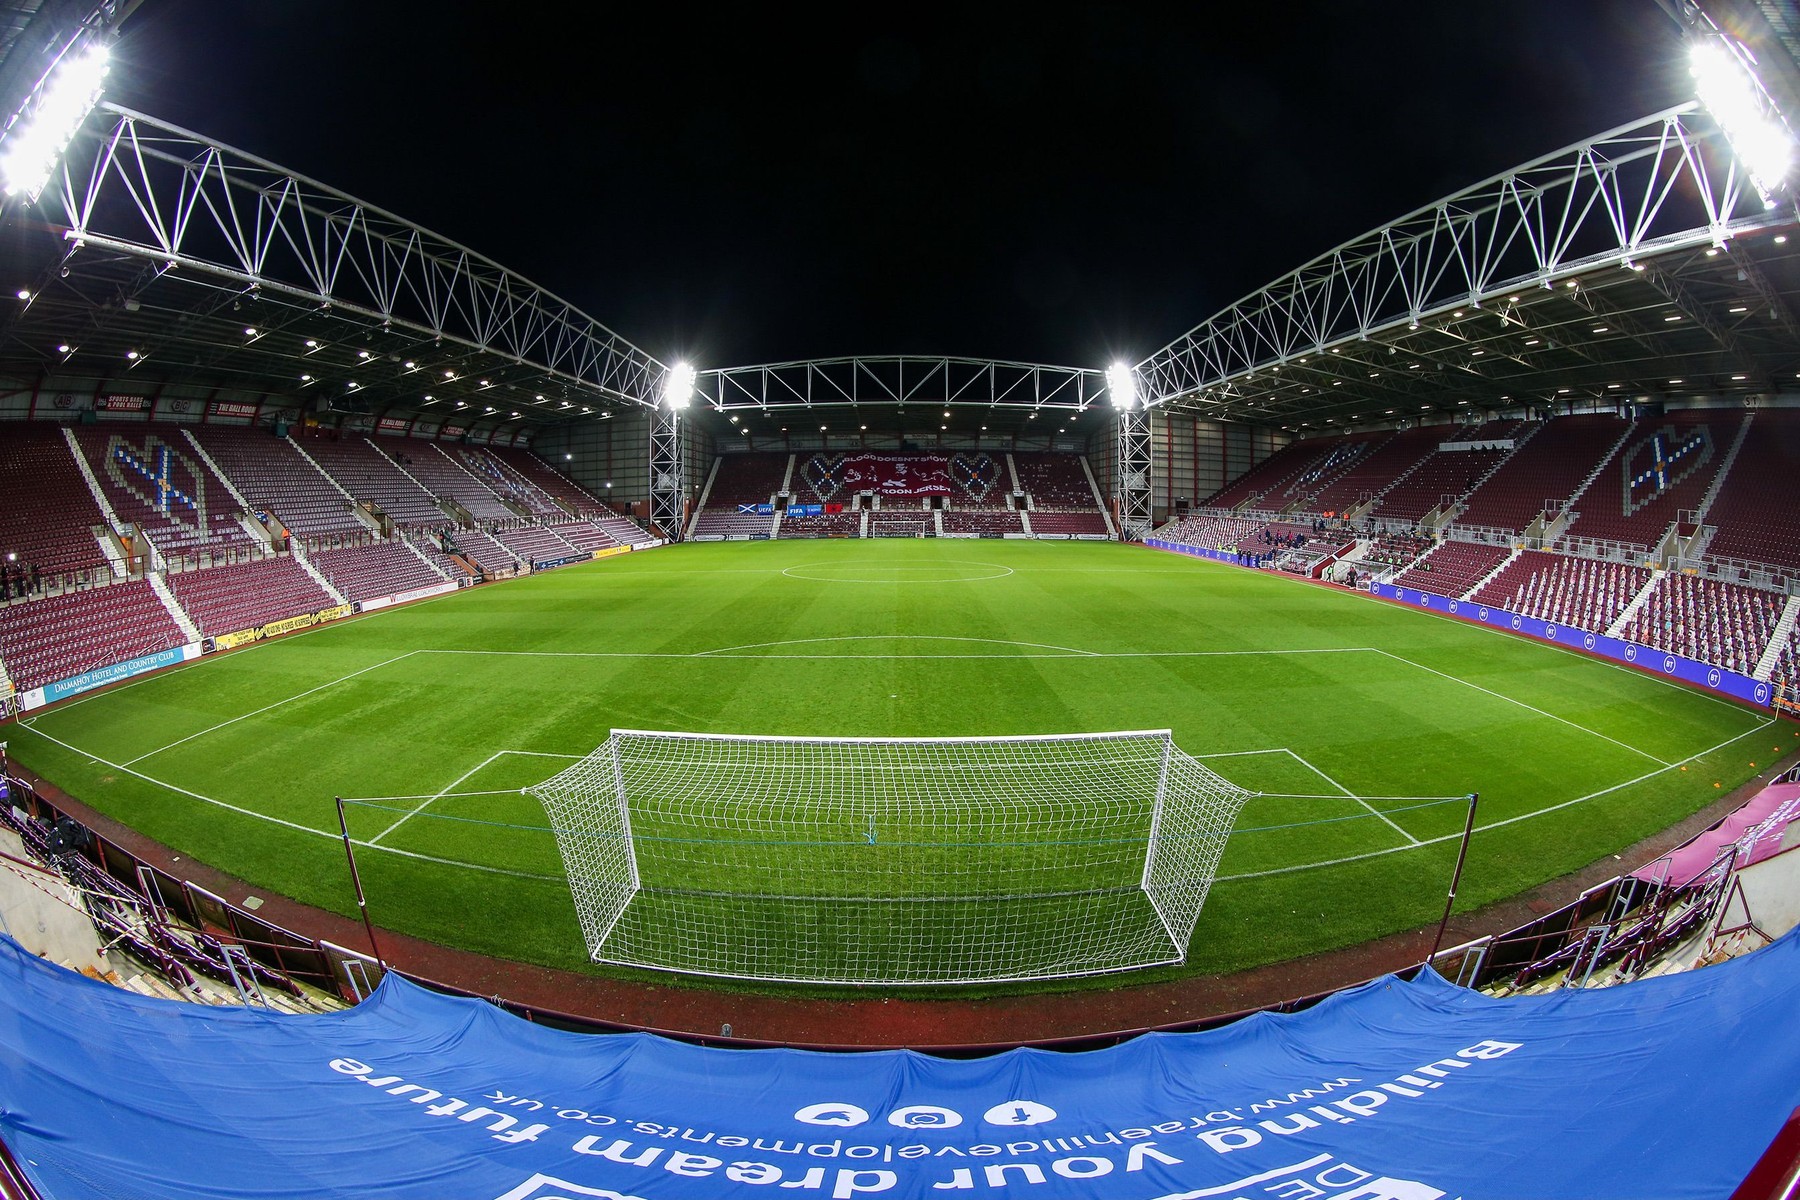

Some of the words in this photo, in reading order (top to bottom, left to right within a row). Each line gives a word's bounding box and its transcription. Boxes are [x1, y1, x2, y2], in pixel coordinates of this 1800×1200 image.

[218, 403, 229, 411] THE
[844, 454, 877, 462] BLOOD
[54, 675, 91, 693] DALMAHOY
[91, 667, 112, 681] HOTEL
[113, 665, 127, 675] AND
[128, 657, 158, 670] COUNTRY
[158, 651, 175, 662] CLUB
[329, 1058, 551, 1143] future
[1197, 1040, 1524, 1153] Building
[572, 1135, 898, 1199] dream
[933, 1142, 1184, 1189] your
